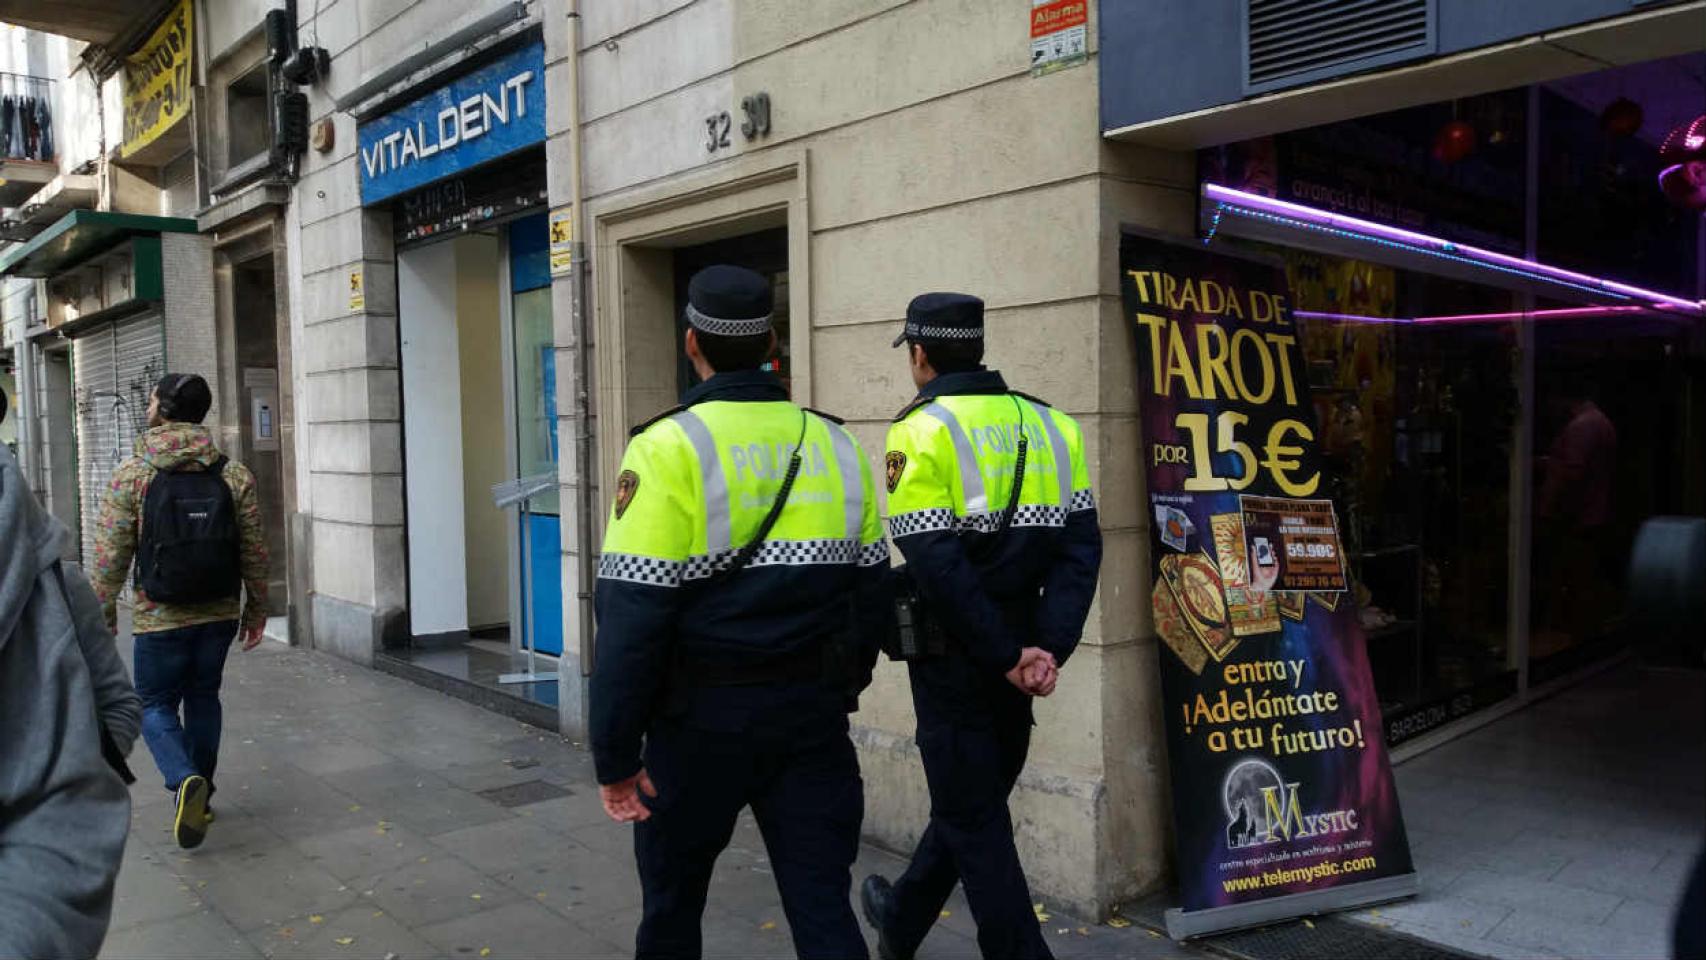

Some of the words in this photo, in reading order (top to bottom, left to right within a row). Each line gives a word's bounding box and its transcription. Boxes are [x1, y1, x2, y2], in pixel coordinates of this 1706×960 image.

[362, 70, 534, 178] VITALDENT
[706, 110, 731, 154] 32
[741, 92, 771, 143] 30
[1128, 270, 1244, 319] TIRADA
[1250, 290, 1291, 326] DE
[1136, 313, 1298, 406] TAROT
[1224, 659, 1287, 685] entra
[1289, 659, 1305, 688] y
[1208, 731, 1227, 752] a
[1231, 727, 1264, 751] tu
[1270, 719, 1367, 756] futuro!
[1222, 855, 1377, 894] www.telemystic.com
